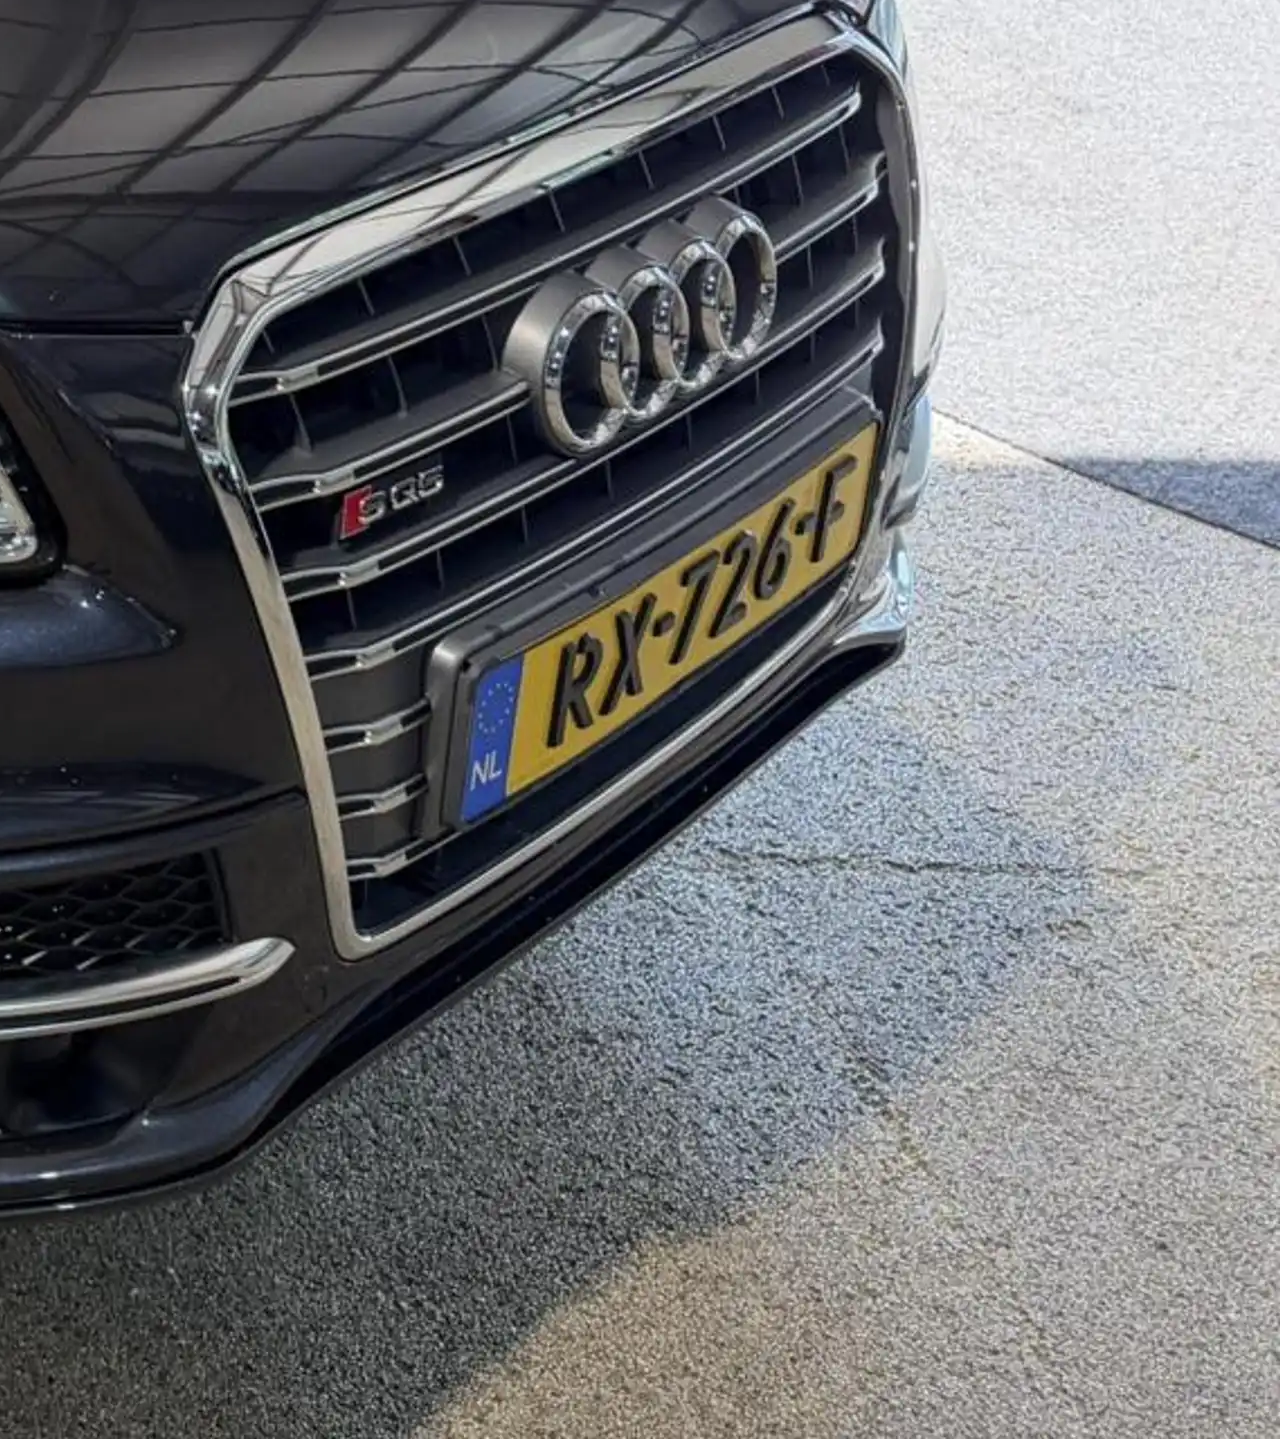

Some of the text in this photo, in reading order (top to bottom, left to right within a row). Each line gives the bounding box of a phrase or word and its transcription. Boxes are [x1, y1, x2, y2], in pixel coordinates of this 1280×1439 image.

[358, 464, 445, 525] SQ5
[546, 453, 858, 748] RX-726-F
[469, 749, 503, 792] NL
